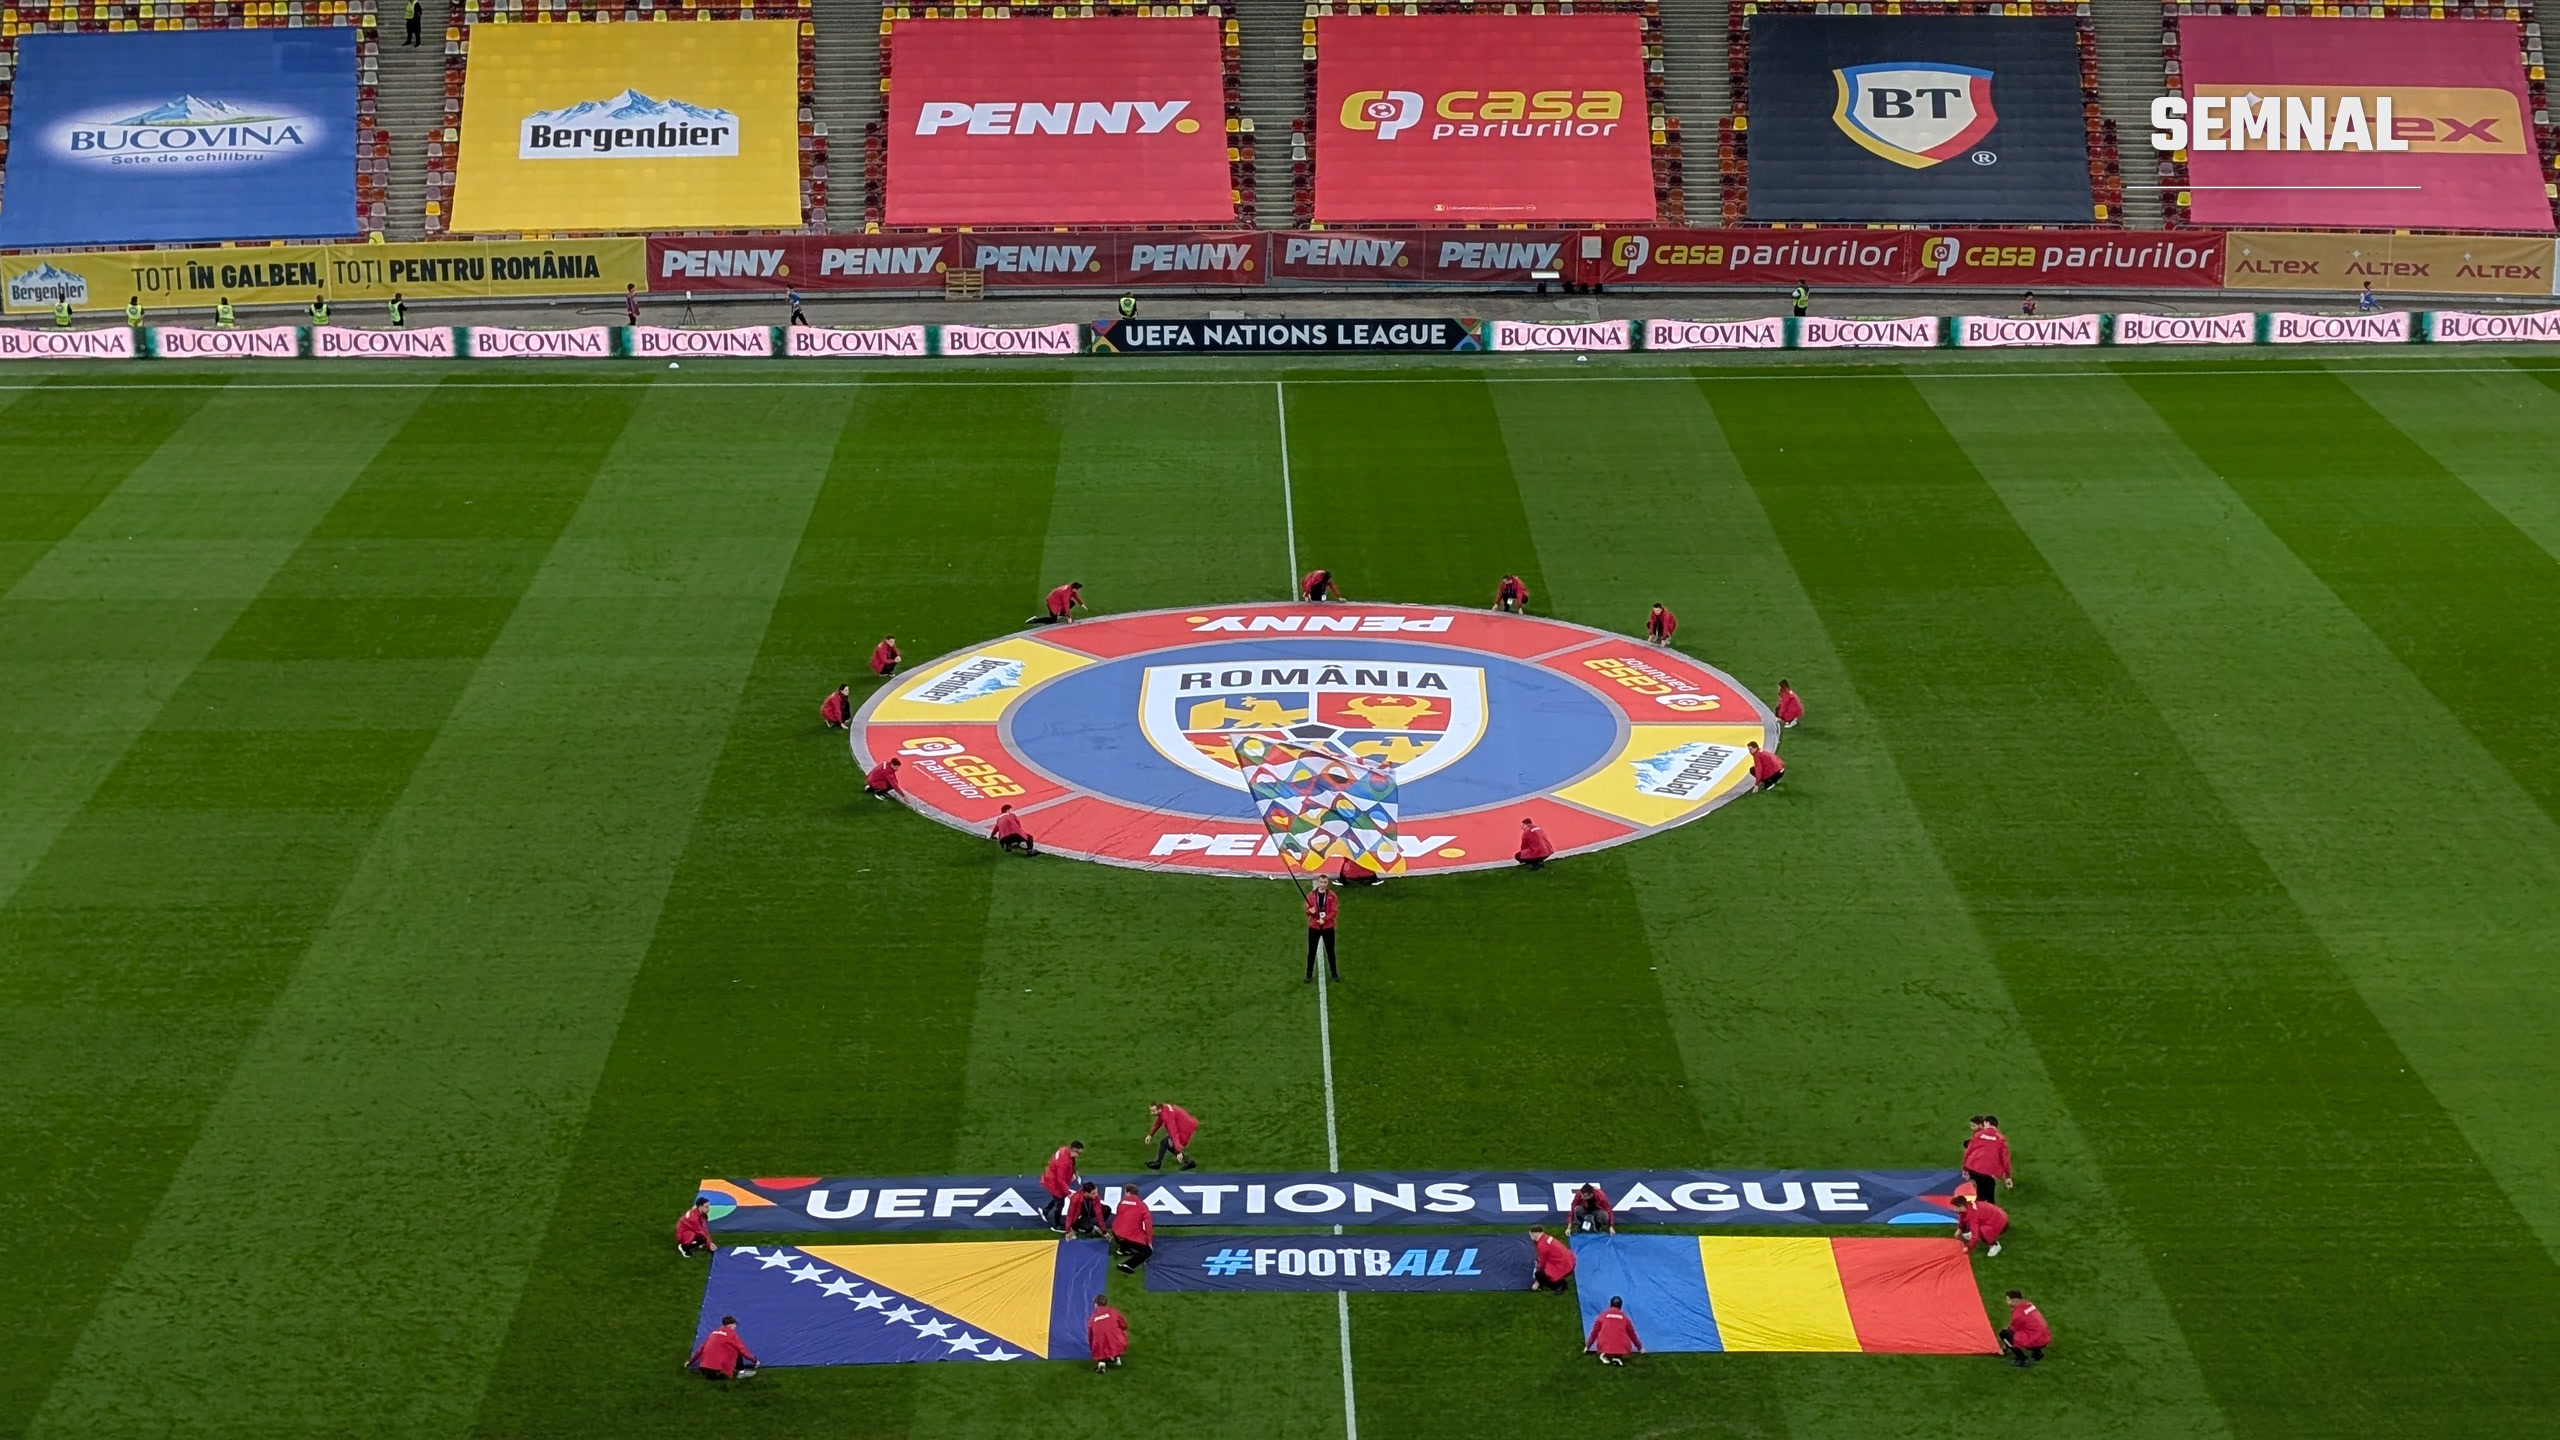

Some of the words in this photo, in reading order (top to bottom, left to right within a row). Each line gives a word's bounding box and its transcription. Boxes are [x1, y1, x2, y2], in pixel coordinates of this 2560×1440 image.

[1436, 90, 1623, 120] casa
[1868, 88, 1962, 119] BT
[71, 125, 304, 150] BUCOVINA
[529, 122, 729, 152] Bergenbier
[1432, 120, 1618, 140] pariurilor
[111, 155, 151, 165] Sete
[157, 154, 179, 164] de
[184, 152, 264, 163] echilibru
[1654, 245, 1724, 266] casa
[1729, 240, 1898, 270] pariurilor
[1965, 246, 2036, 267] casa
[2041, 242, 2215, 272] pariurilor
[186, 261, 214, 289] ÎN
[221, 262, 324, 289] GALBEN,
[390, 257, 485, 282] PENTRU
[491, 250, 600, 280] ROMÂNIA
[11, 282, 85, 302] Bergenbier
[1125, 325, 1195, 346] UEFA
[1204, 324, 1327, 346] NATIONS
[1338, 324, 1446, 345] LEAGUE
[1501, 327, 1621, 346] BUCOVINA
[1654, 325, 1775, 344] BUCOVINA
[1808, 324, 1928, 342] BUCOVINA
[1969, 322, 2091, 341] BUCOVINA
[2124, 320, 2246, 339] BUCOVINA
[2279, 318, 2400, 338] BUCOVINA
[2, 334, 125, 352] BUCOVINA
[166, 334, 290, 352] BUCOVINA
[323, 334, 446, 352] BUCOVINA
[479, 334, 602, 352] BUCOVINA
[642, 332, 764, 352] BUCOVINA
[796, 332, 918, 351] BUCOVINA
[950, 331, 1071, 350] BUCOVINA
[918, 659, 1012, 702] Bergenbier
[1180, 664, 1448, 690] ROMÂNIA
[1583, 658, 1672, 695] casa
[1619, 657, 1700, 692] pariurilor
[912, 759, 985, 800] pariurilor
[943, 755, 1026, 798] casa
[1653, 745, 1734, 797] Bergenbier
[806, 1187, 1039, 1219] UEFA
[1498, 1180, 1869, 1212] LEAGUE
[1202, 1248, 1482, 1276] #FOOTBALL
